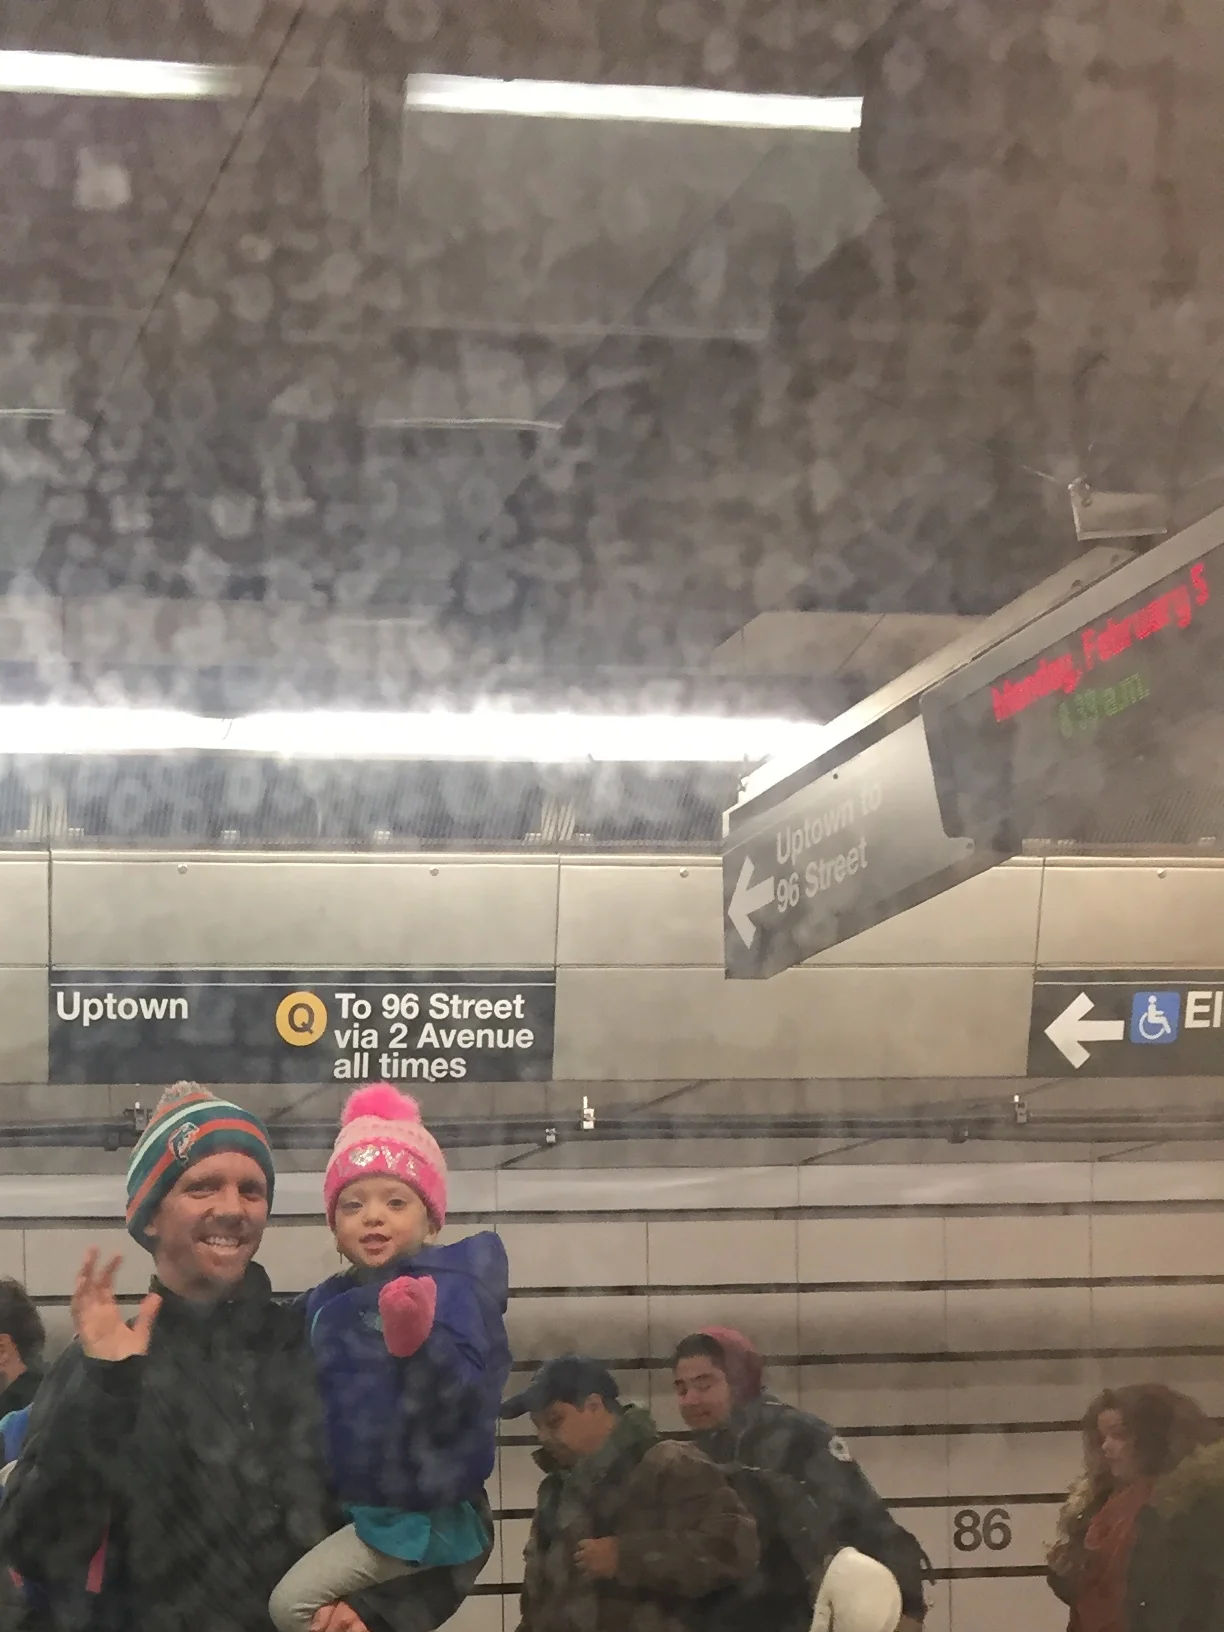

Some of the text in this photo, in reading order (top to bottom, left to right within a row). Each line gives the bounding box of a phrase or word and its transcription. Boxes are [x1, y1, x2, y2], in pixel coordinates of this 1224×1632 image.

[776, 781, 882, 866] Uptown to
[777, 836, 868, 913] 96 Street
[57, 991, 188, 1027] Uptown
[288, 1003, 314, 1034] Q
[334, 993, 525, 1020] To 96 Street
[334, 1023, 534, 1049] via 2 Avenue
[333, 1052, 467, 1079] all times
[953, 1508, 1012, 1552] 86
